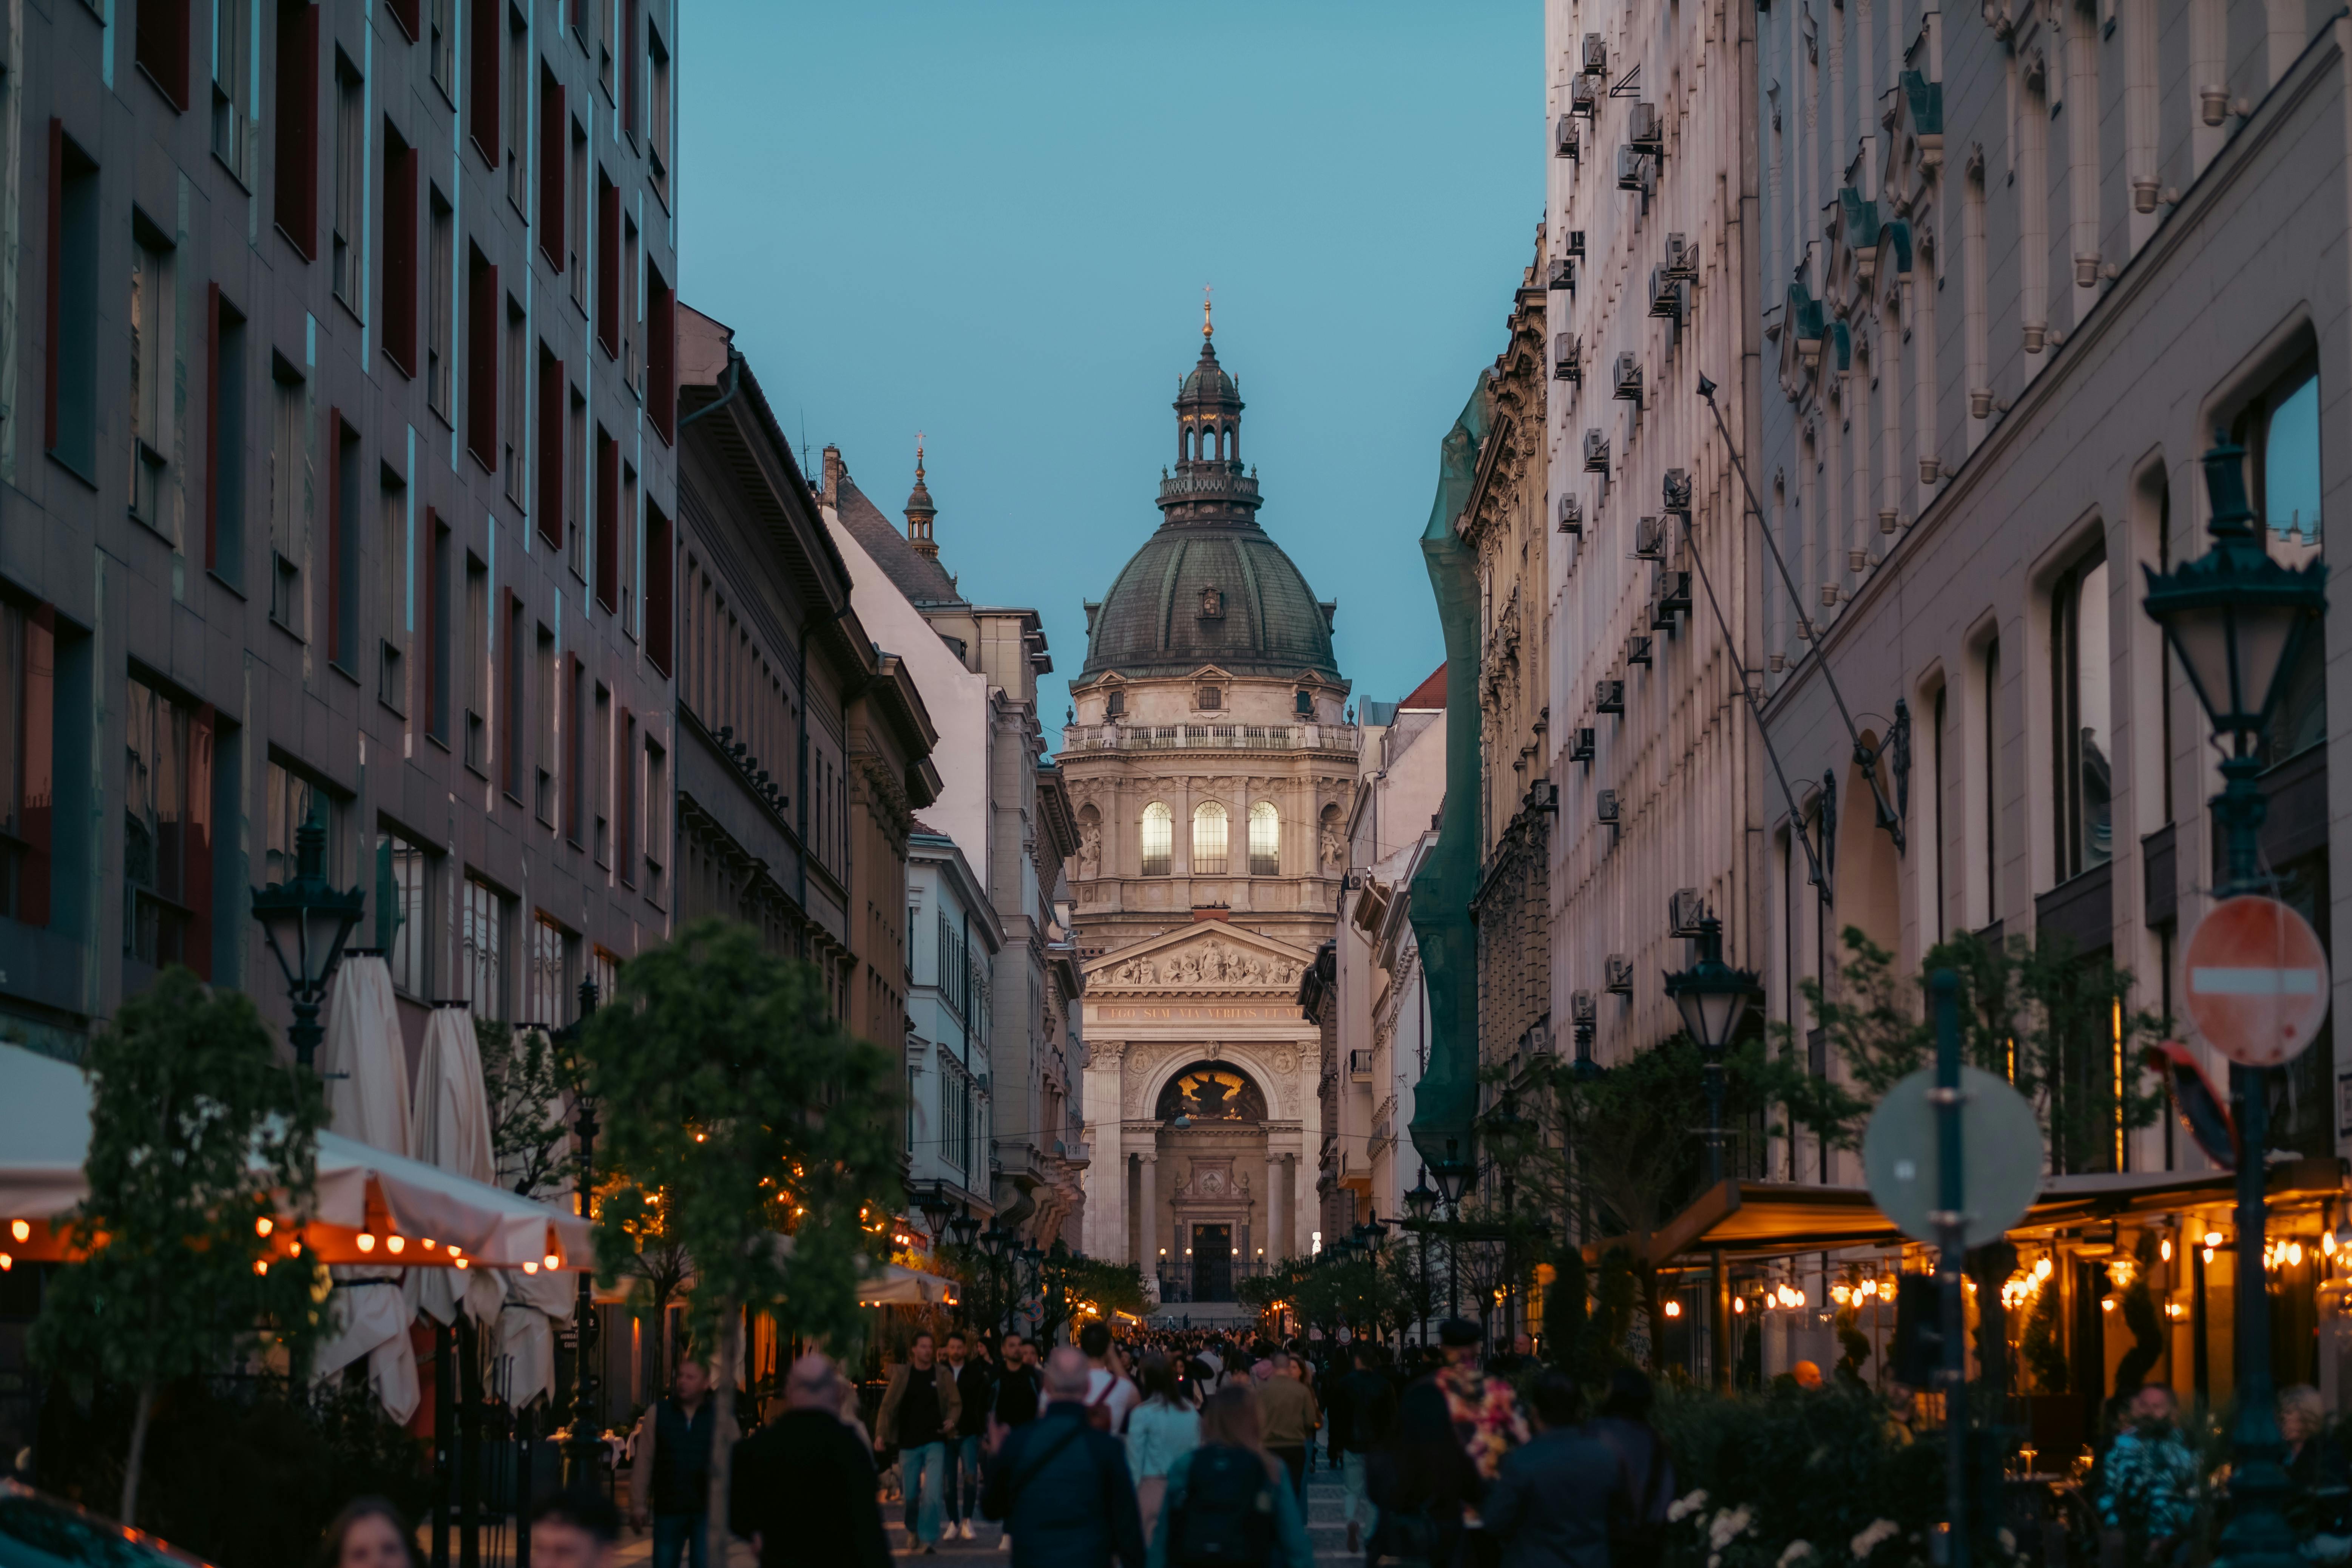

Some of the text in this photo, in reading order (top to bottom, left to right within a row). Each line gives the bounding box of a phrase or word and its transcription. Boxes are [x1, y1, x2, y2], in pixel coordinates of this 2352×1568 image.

[1144, 1009, 1170, 1018] SUM
[1180, 1009, 1199, 1018] VIA
[1208, 1009, 1256, 1018] VERITAS
[1265, 1009, 1278, 1018] ET
